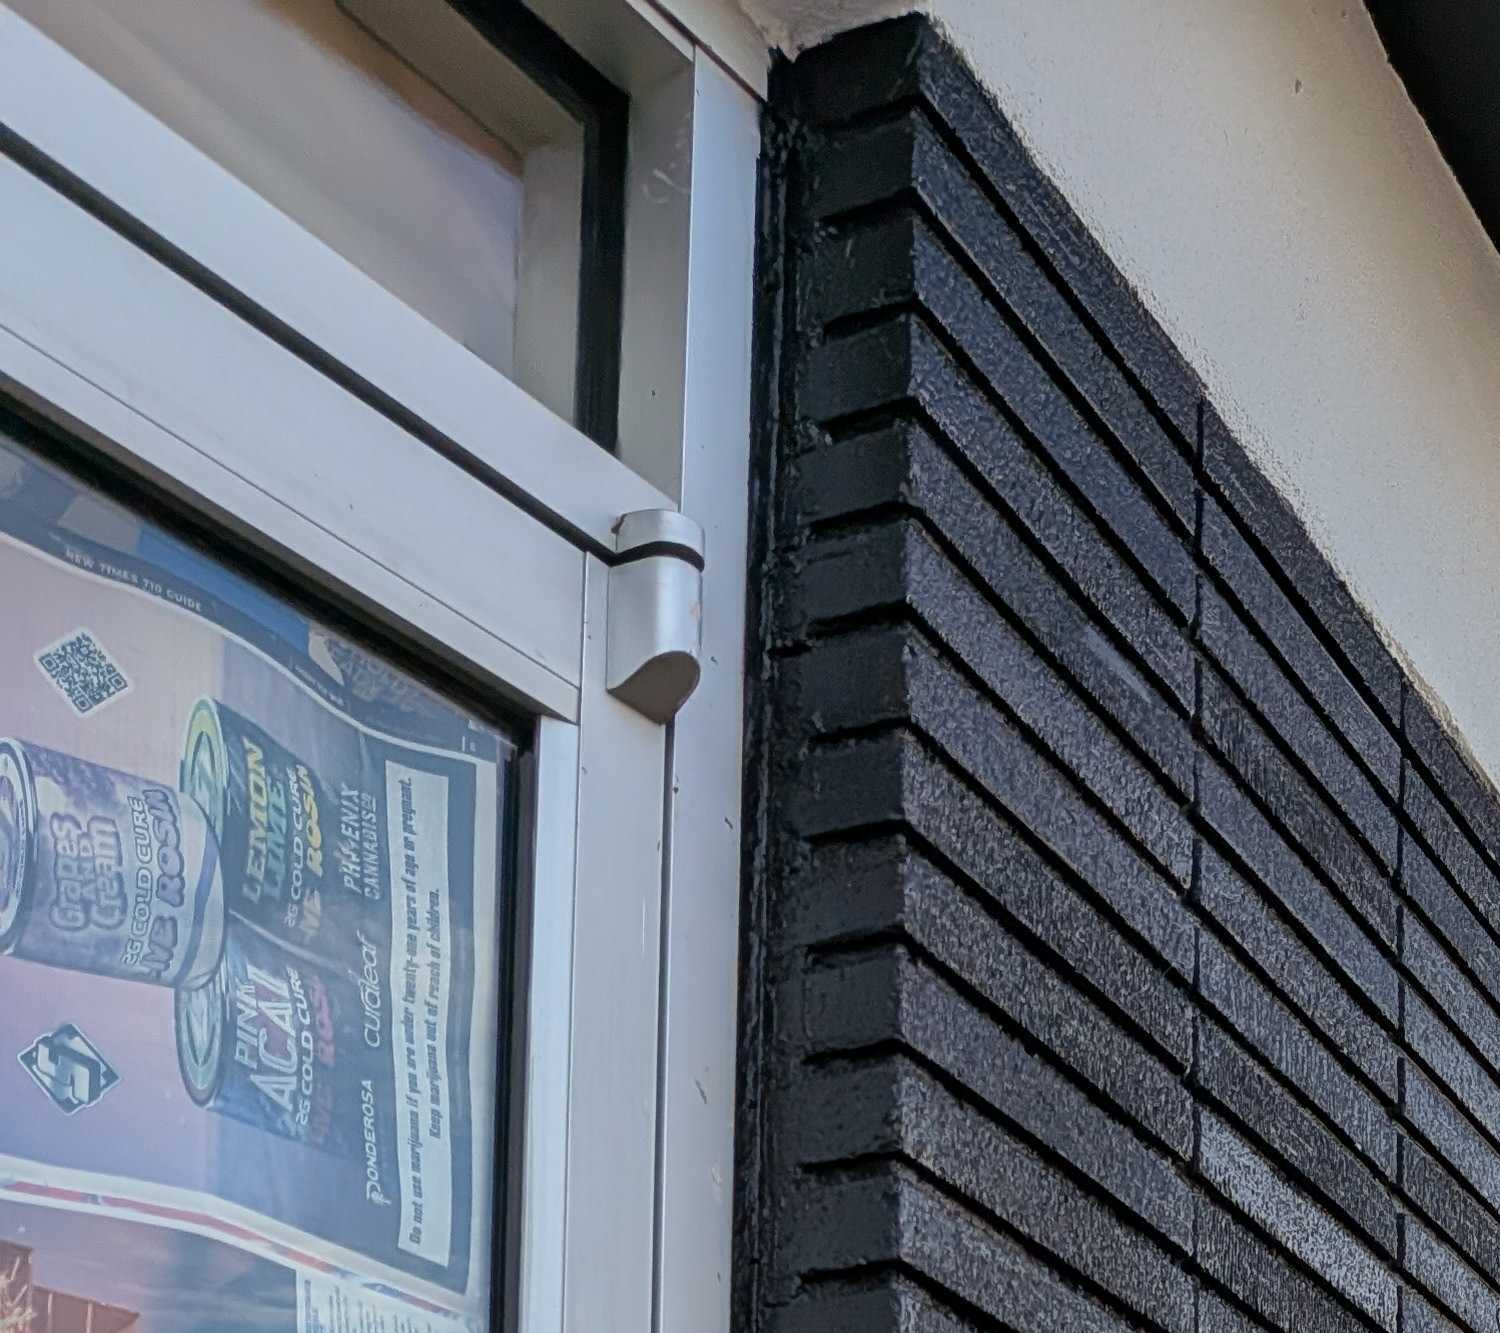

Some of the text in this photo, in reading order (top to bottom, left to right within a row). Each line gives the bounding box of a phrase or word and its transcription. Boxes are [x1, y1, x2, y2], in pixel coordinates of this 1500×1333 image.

[127, 795, 151, 862] CURE
[240, 736, 268, 902] LEMON
[50, 812, 90, 930] Grapes
[88, 814, 126, 928] Cream
[290, 838, 304, 900] COLD
[403, 854, 419, 877] age
[130, 868, 152, 934] COLD
[404, 896, 420, 930] years
[352, 929, 382, 1048] curaleaf
[299, 1031, 313, 1095] COLD
[408, 1074, 421, 1094] you
[361, 1080, 391, 1208] PONDEROSA
[407, 1110, 424, 1173] marijuana
[409, 1202, 424, 1224] not
